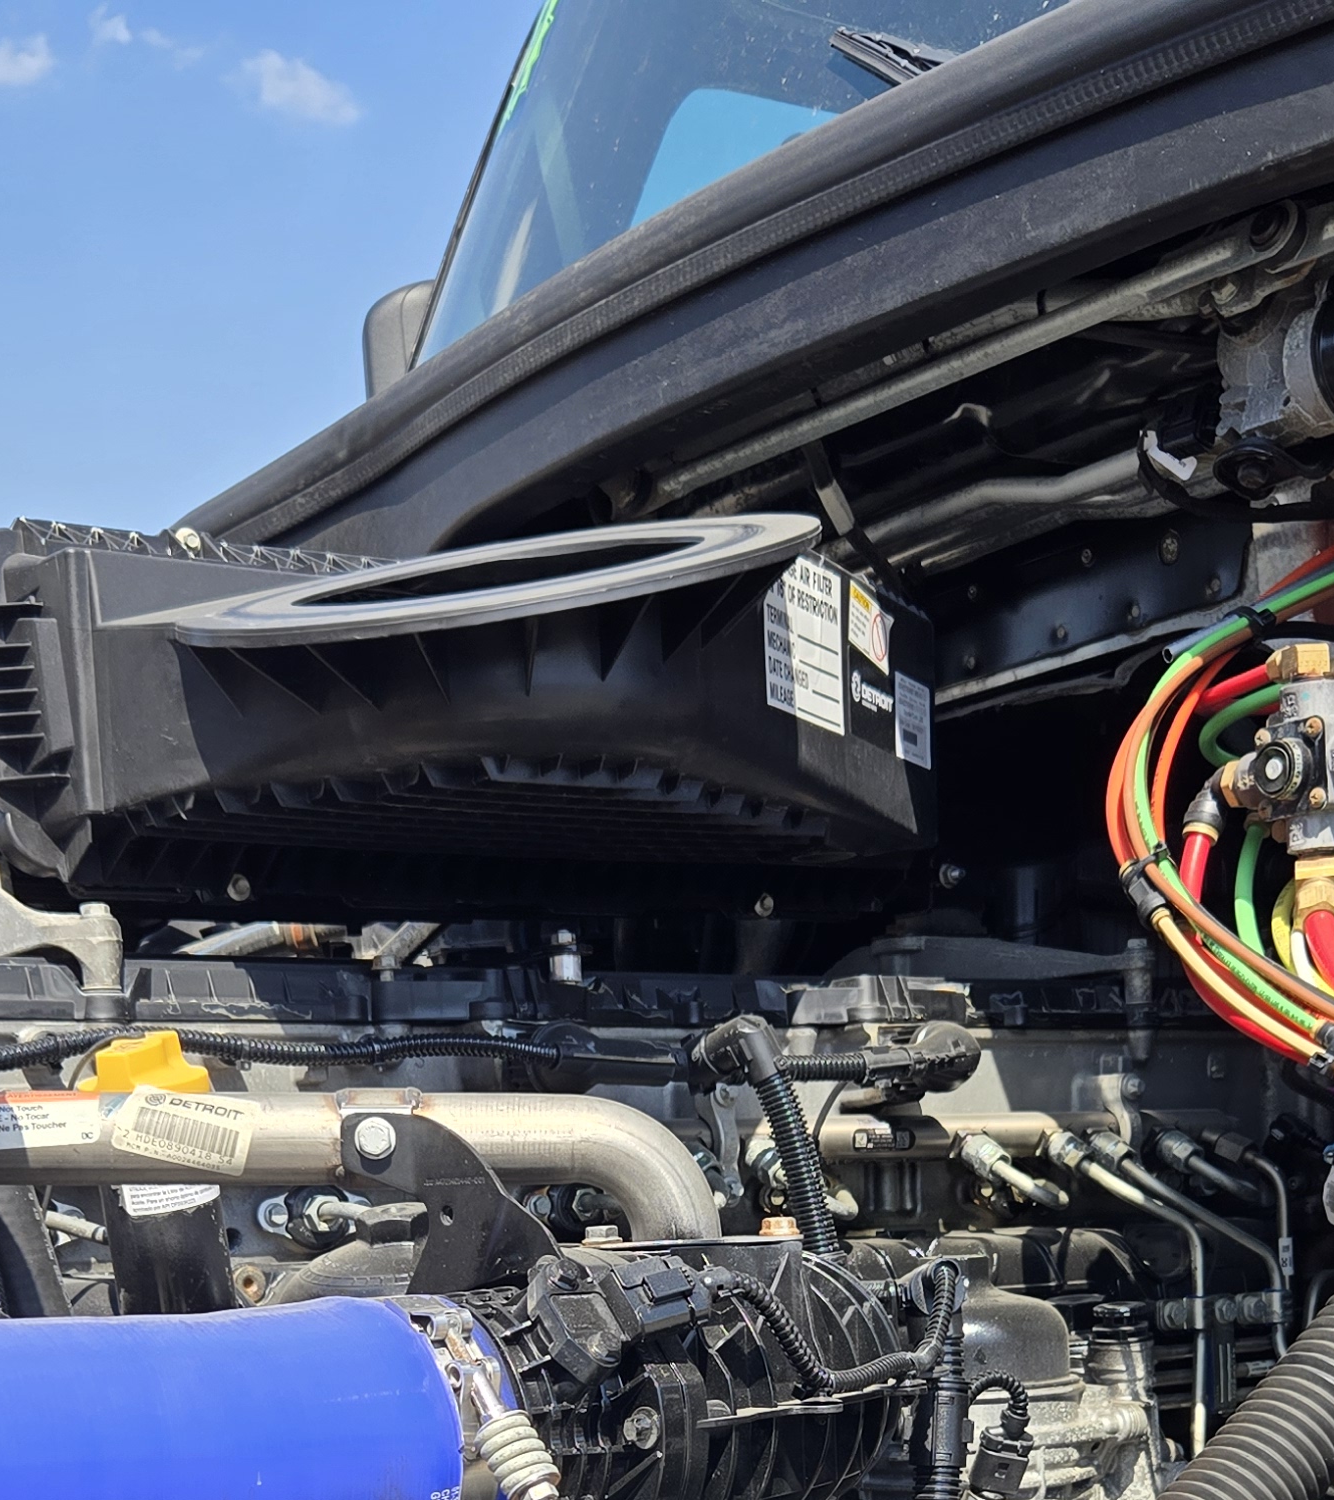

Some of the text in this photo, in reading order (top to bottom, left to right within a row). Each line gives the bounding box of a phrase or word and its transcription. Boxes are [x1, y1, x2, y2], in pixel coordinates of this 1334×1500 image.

[799, 564, 811, 588] AIR
[813, 571, 833, 598] FILTER
[797, 588, 838, 626] RESTRICTION
[768, 655, 782, 677] DATE
[769, 682, 795, 708] MILEAGE
[862, 682, 894, 713] DETROIT
[11, 1113, 23, 1122] No
[169, 1097, 244, 1121] DETROIT
[32, 1121, 67, 1130] Toucher
